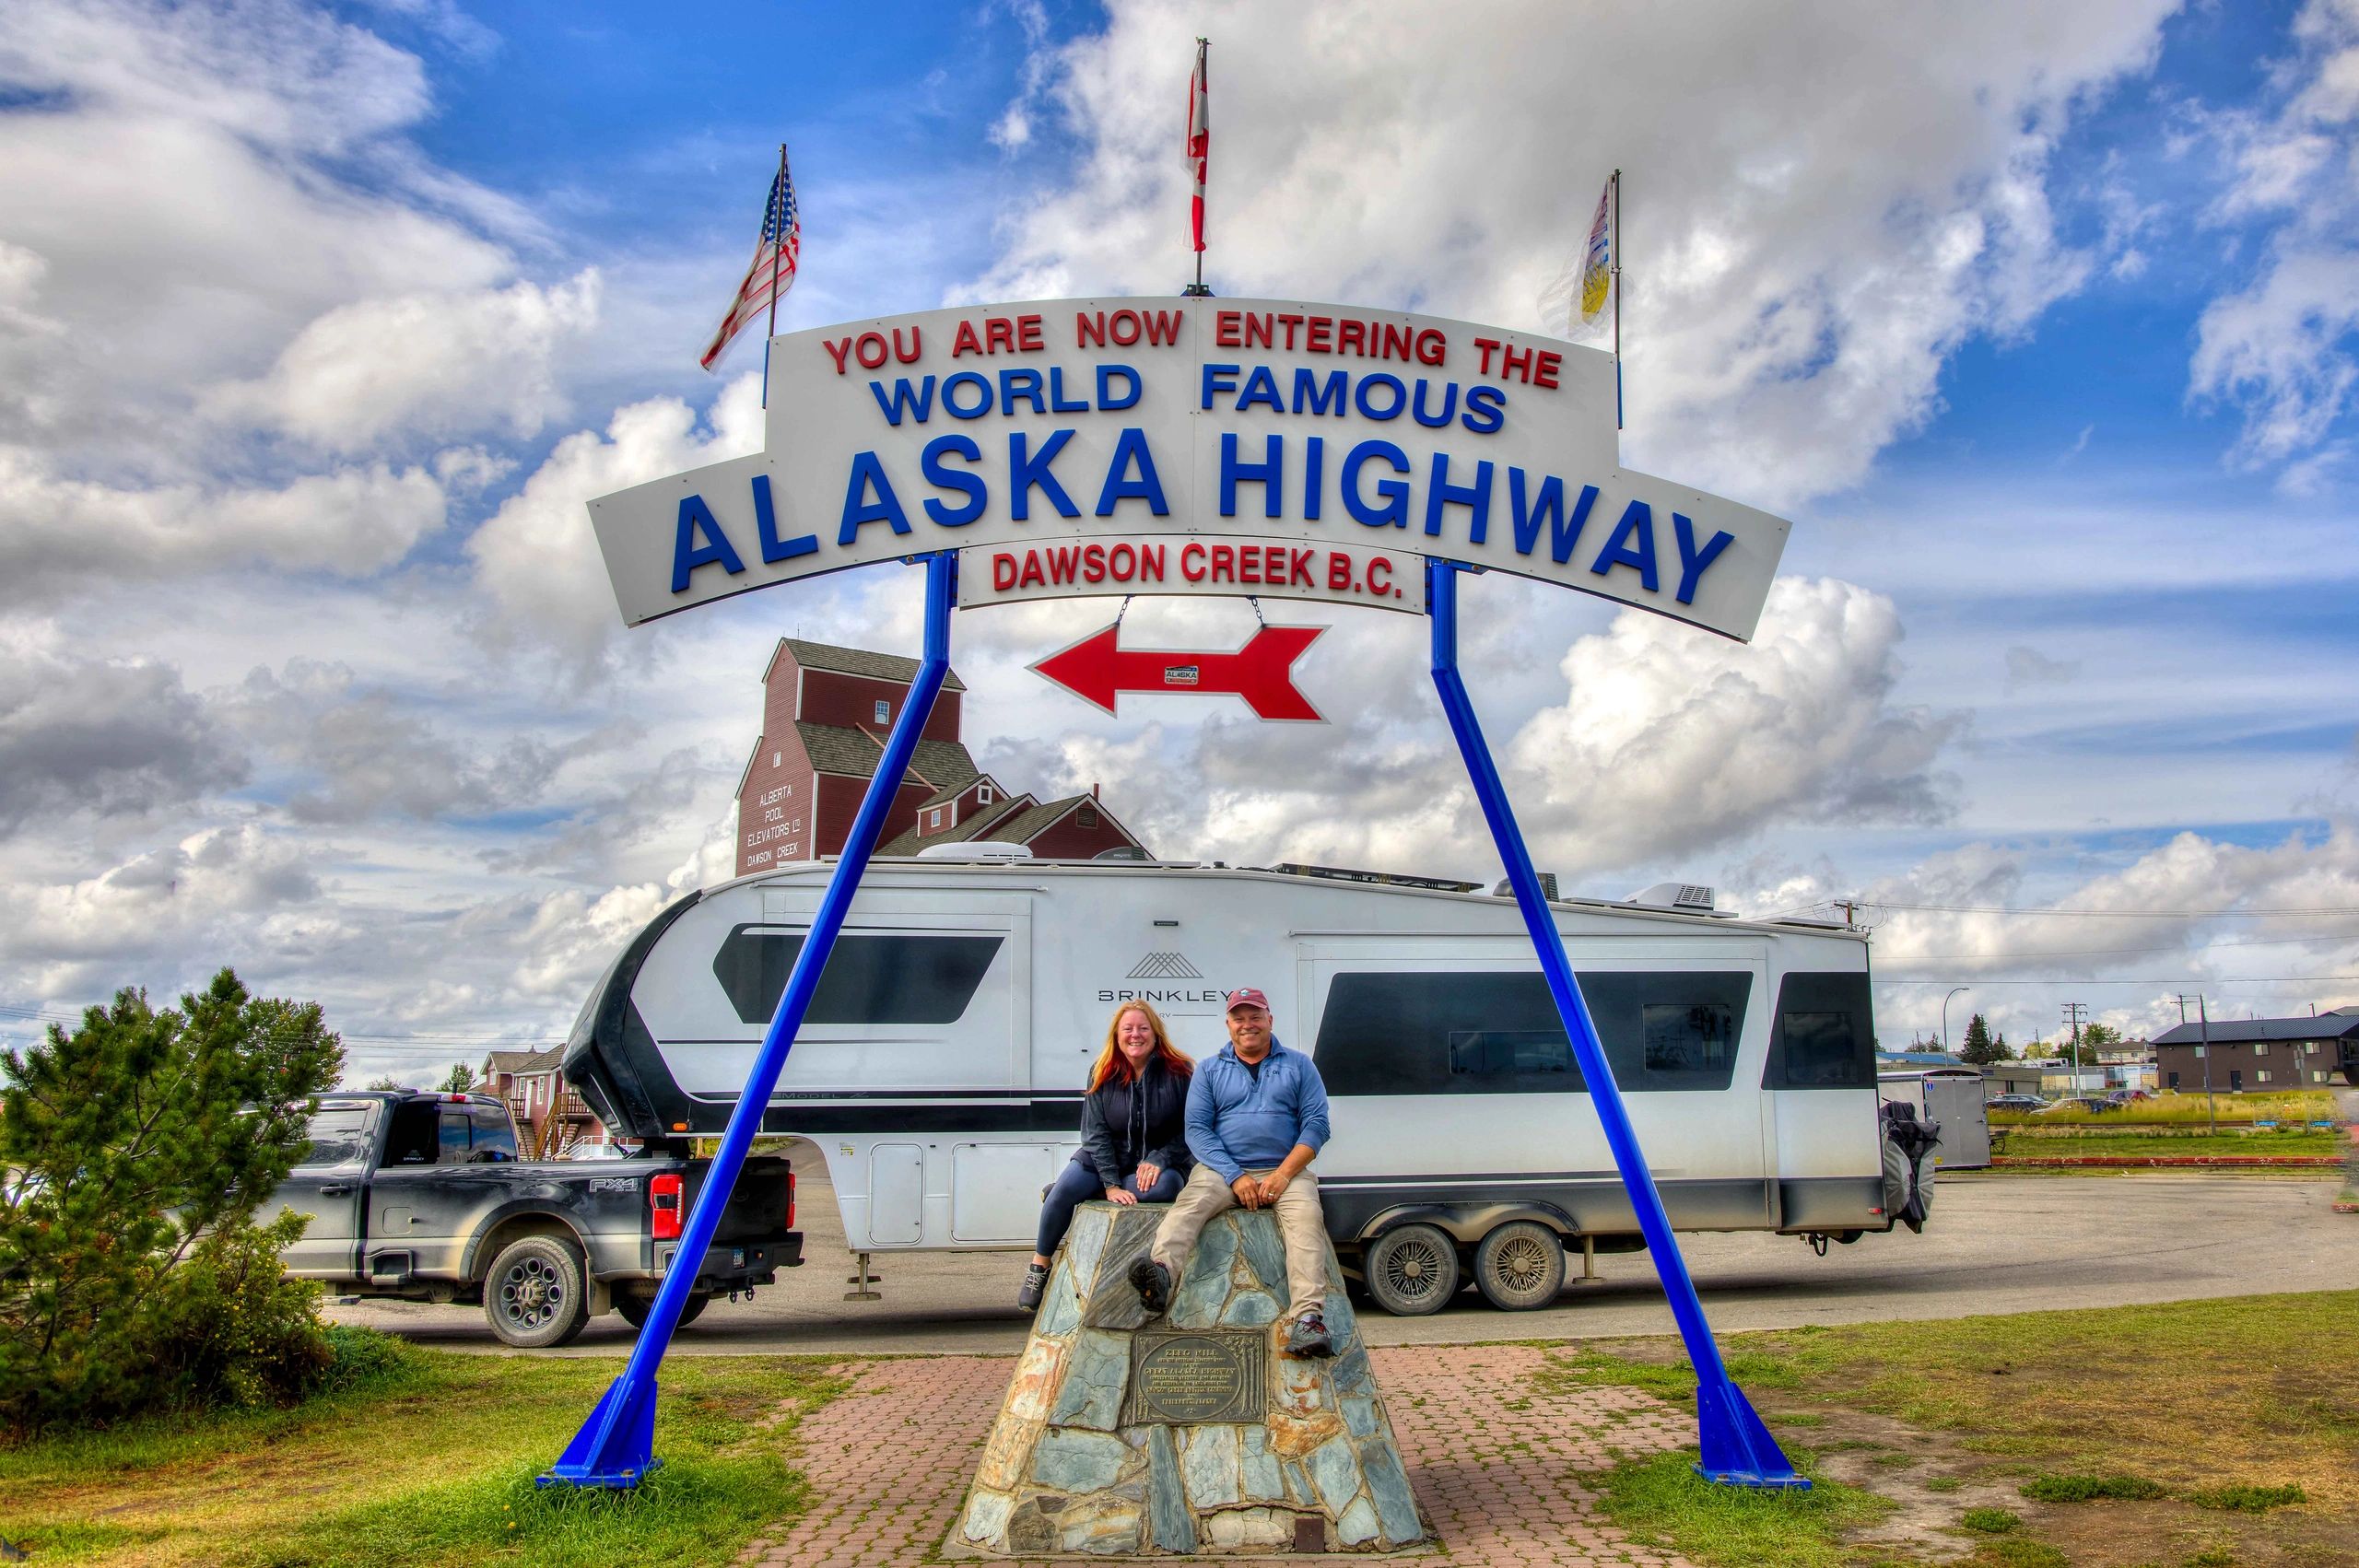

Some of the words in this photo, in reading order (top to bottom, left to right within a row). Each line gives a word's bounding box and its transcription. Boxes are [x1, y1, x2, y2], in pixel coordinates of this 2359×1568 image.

[824, 326, 921, 374] YOU
[952, 314, 1044, 357] ARE
[1076, 309, 1183, 347] NOW
[1215, 310, 1446, 366] ENTERING
[1473, 338, 1563, 390] THE
[869, 364, 1143, 426] WORLD
[1201, 363, 1508, 434] FAMOUS
[671, 427, 1169, 594] ALASKA
[1219, 433, 1735, 605] HIGHWAY
[992, 543, 1165, 591] DAWSON
[1180, 544, 1315, 587] CREEK
[1328, 553, 1402, 598] B.C.
[759, 784, 792, 807] ALBERTA
[765, 806, 783, 823] POOL
[747, 823, 790, 847] ELEVATORS
[747, 849, 772, 867] DAWSON
[777, 842, 798, 858] CREEK
[1098, 990, 1234, 1001] BRINKLEY
[589, 1177, 639, 1193] FX4
